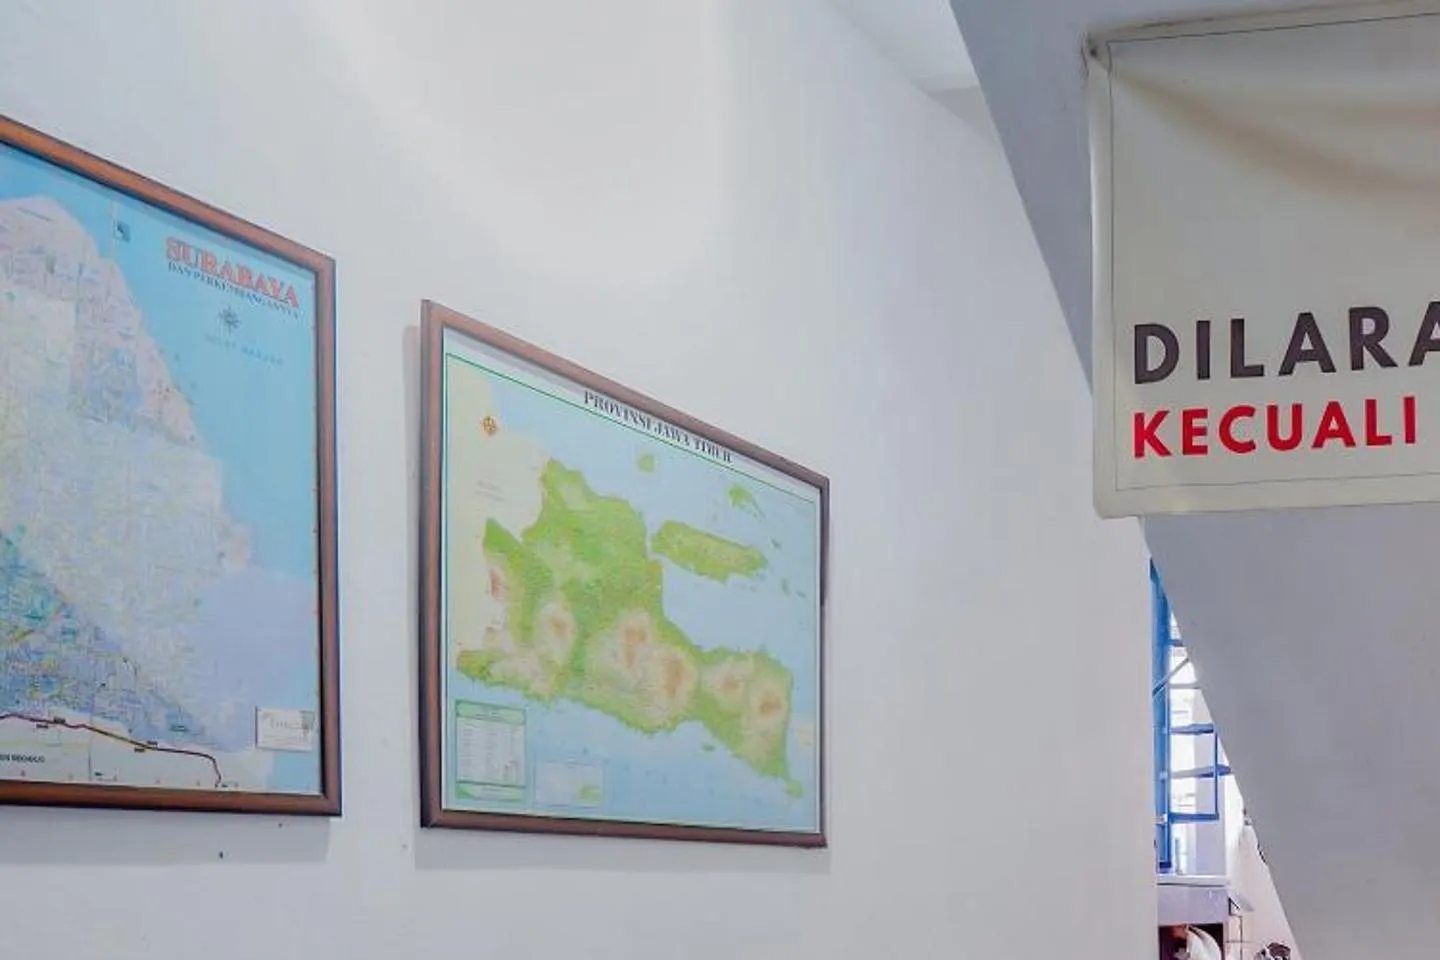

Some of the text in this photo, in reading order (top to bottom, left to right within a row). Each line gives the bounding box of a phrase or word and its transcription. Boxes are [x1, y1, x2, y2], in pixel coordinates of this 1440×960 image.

[166, 235, 299, 309] SURABAYA
[584, 390, 650, 430] PROVINSI
[653, 421, 690, 446] JAWA
[1133, 396, 1417, 459] KECUALI
